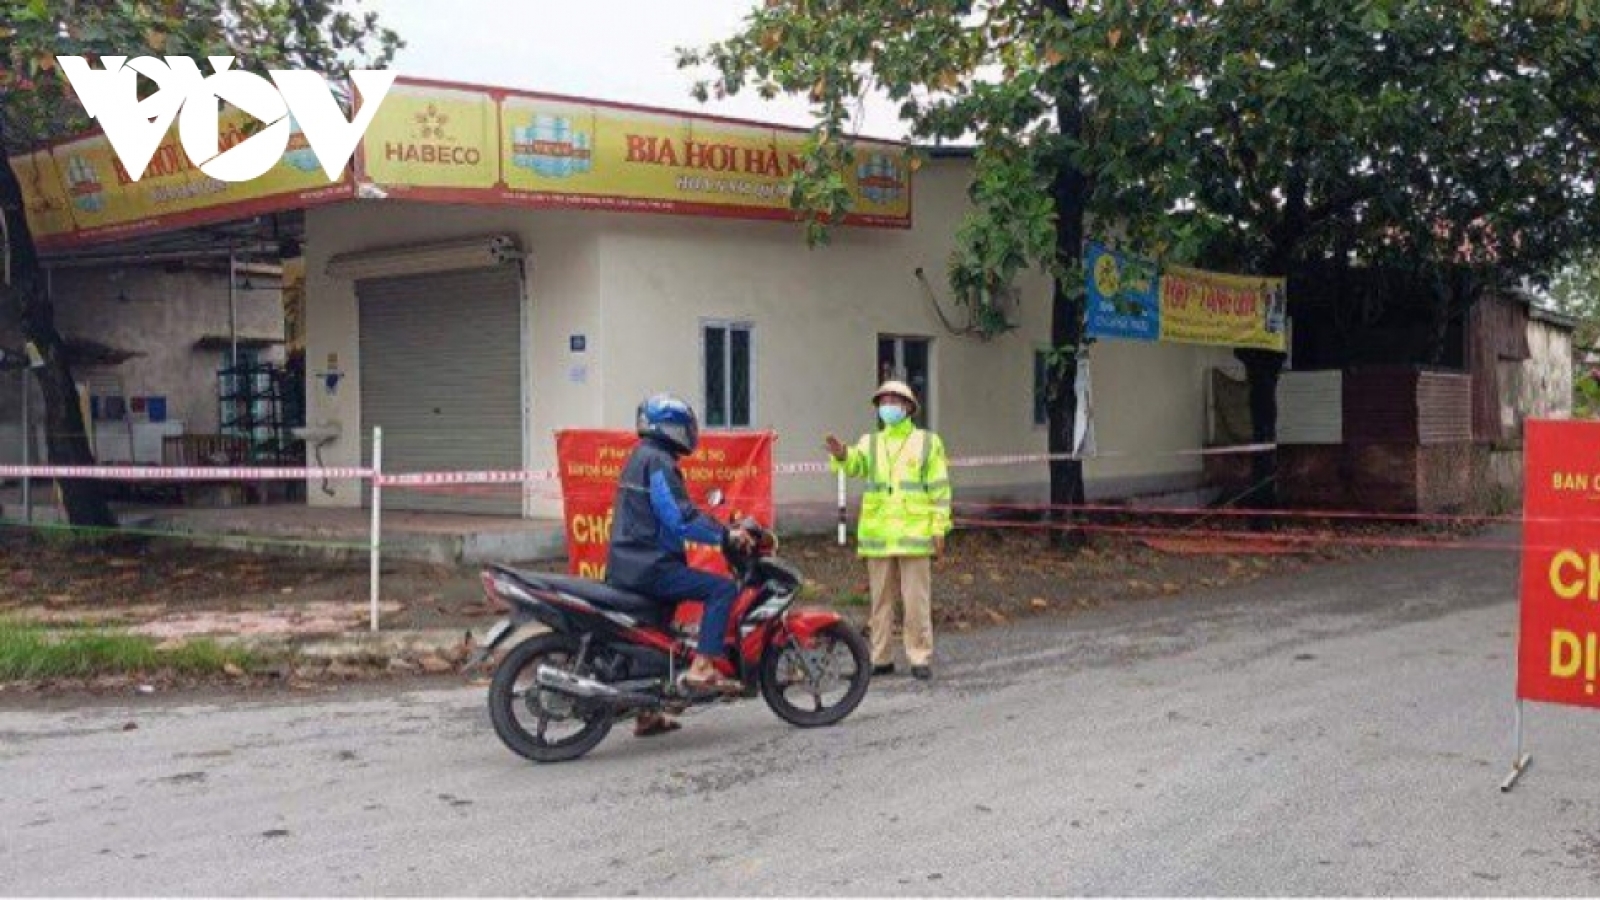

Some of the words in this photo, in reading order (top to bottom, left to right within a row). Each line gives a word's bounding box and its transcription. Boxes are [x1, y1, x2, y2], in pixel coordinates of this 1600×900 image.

[385, 142, 480, 166] HABECO
[626, 134, 677, 167] BIA
[1553, 472, 1587, 490] BAN
[1551, 629, 1600, 694] DỊ
